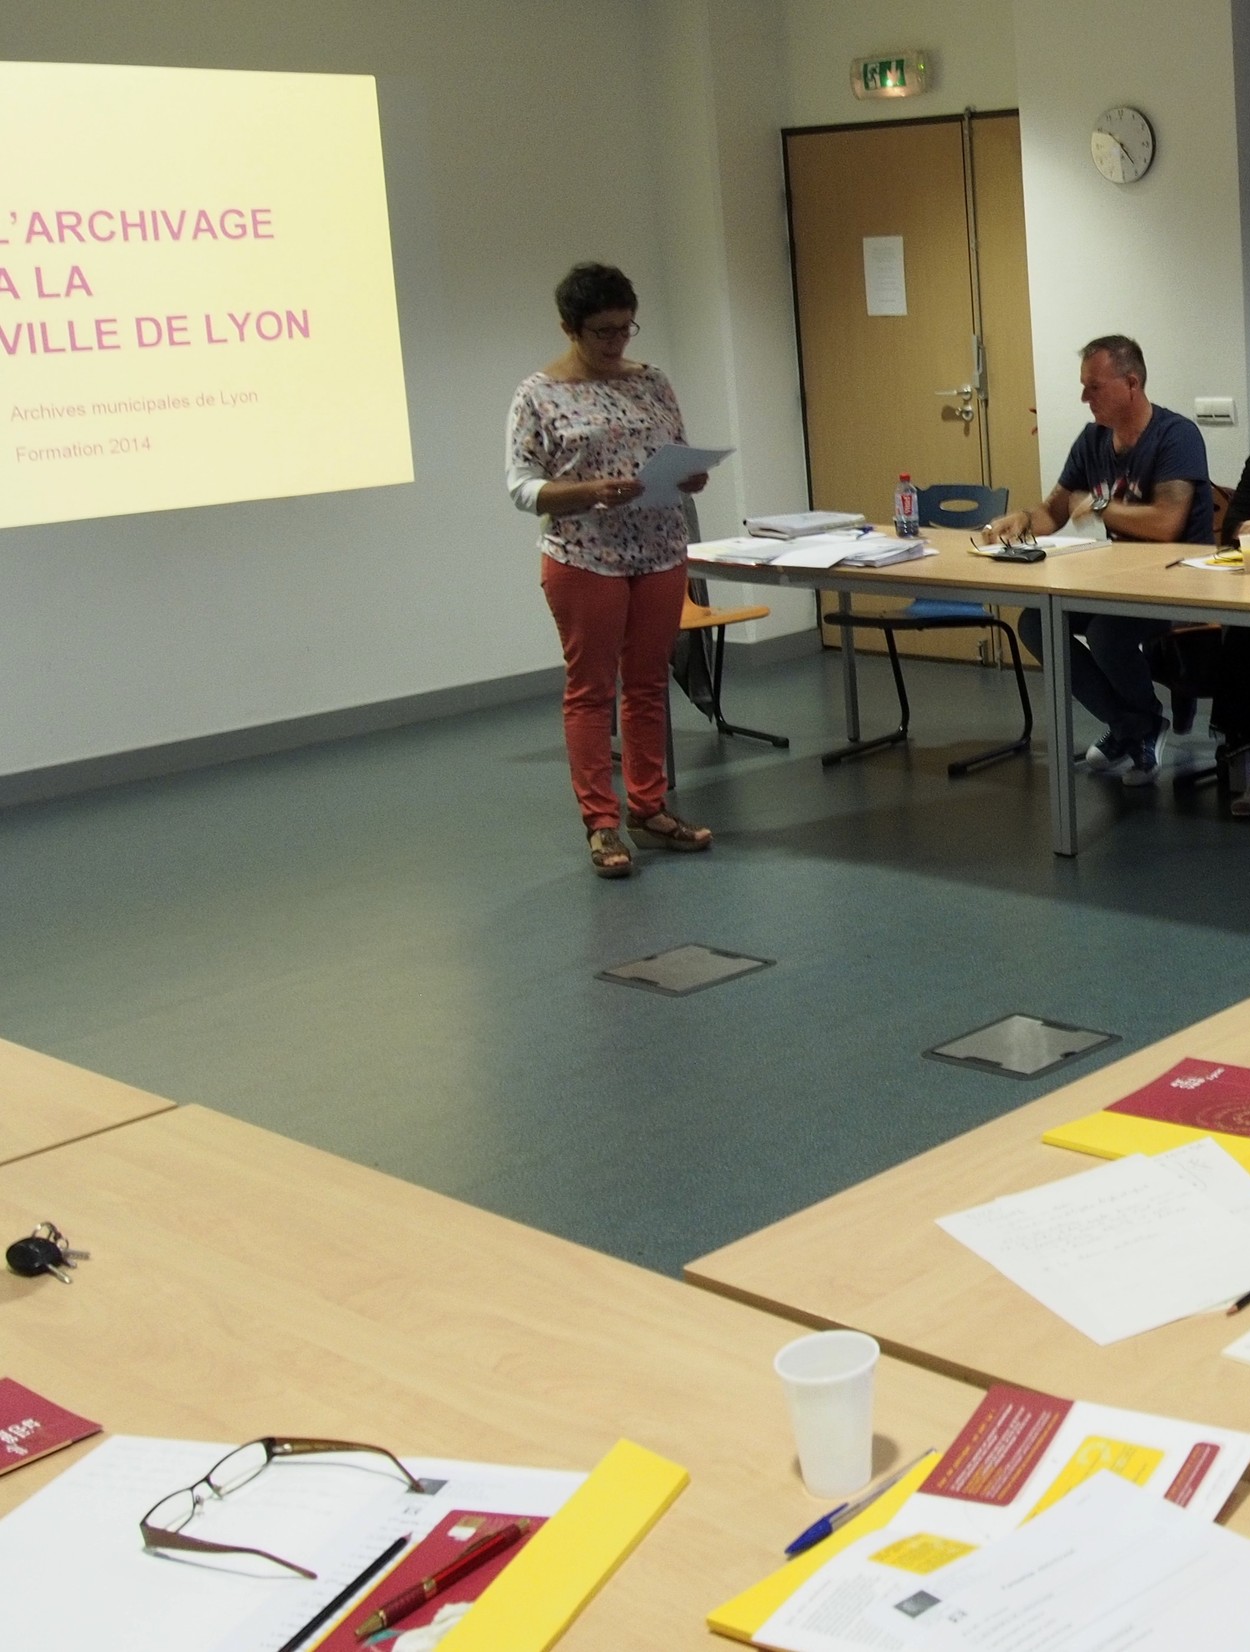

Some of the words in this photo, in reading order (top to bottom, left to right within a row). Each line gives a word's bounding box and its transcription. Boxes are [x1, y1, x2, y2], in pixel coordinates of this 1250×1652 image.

[34, 265, 94, 299] LA
[0, 317, 122, 355] VILLE
[134, 314, 192, 348] DE
[204, 308, 311, 344] LYON
[10, 404, 87, 422] Archives
[92, 394, 191, 415] municipales
[195, 392, 215, 407] de
[220, 389, 259, 408] Lyon
[15, 441, 104, 463] Formation
[108, 435, 152, 455] 2014
